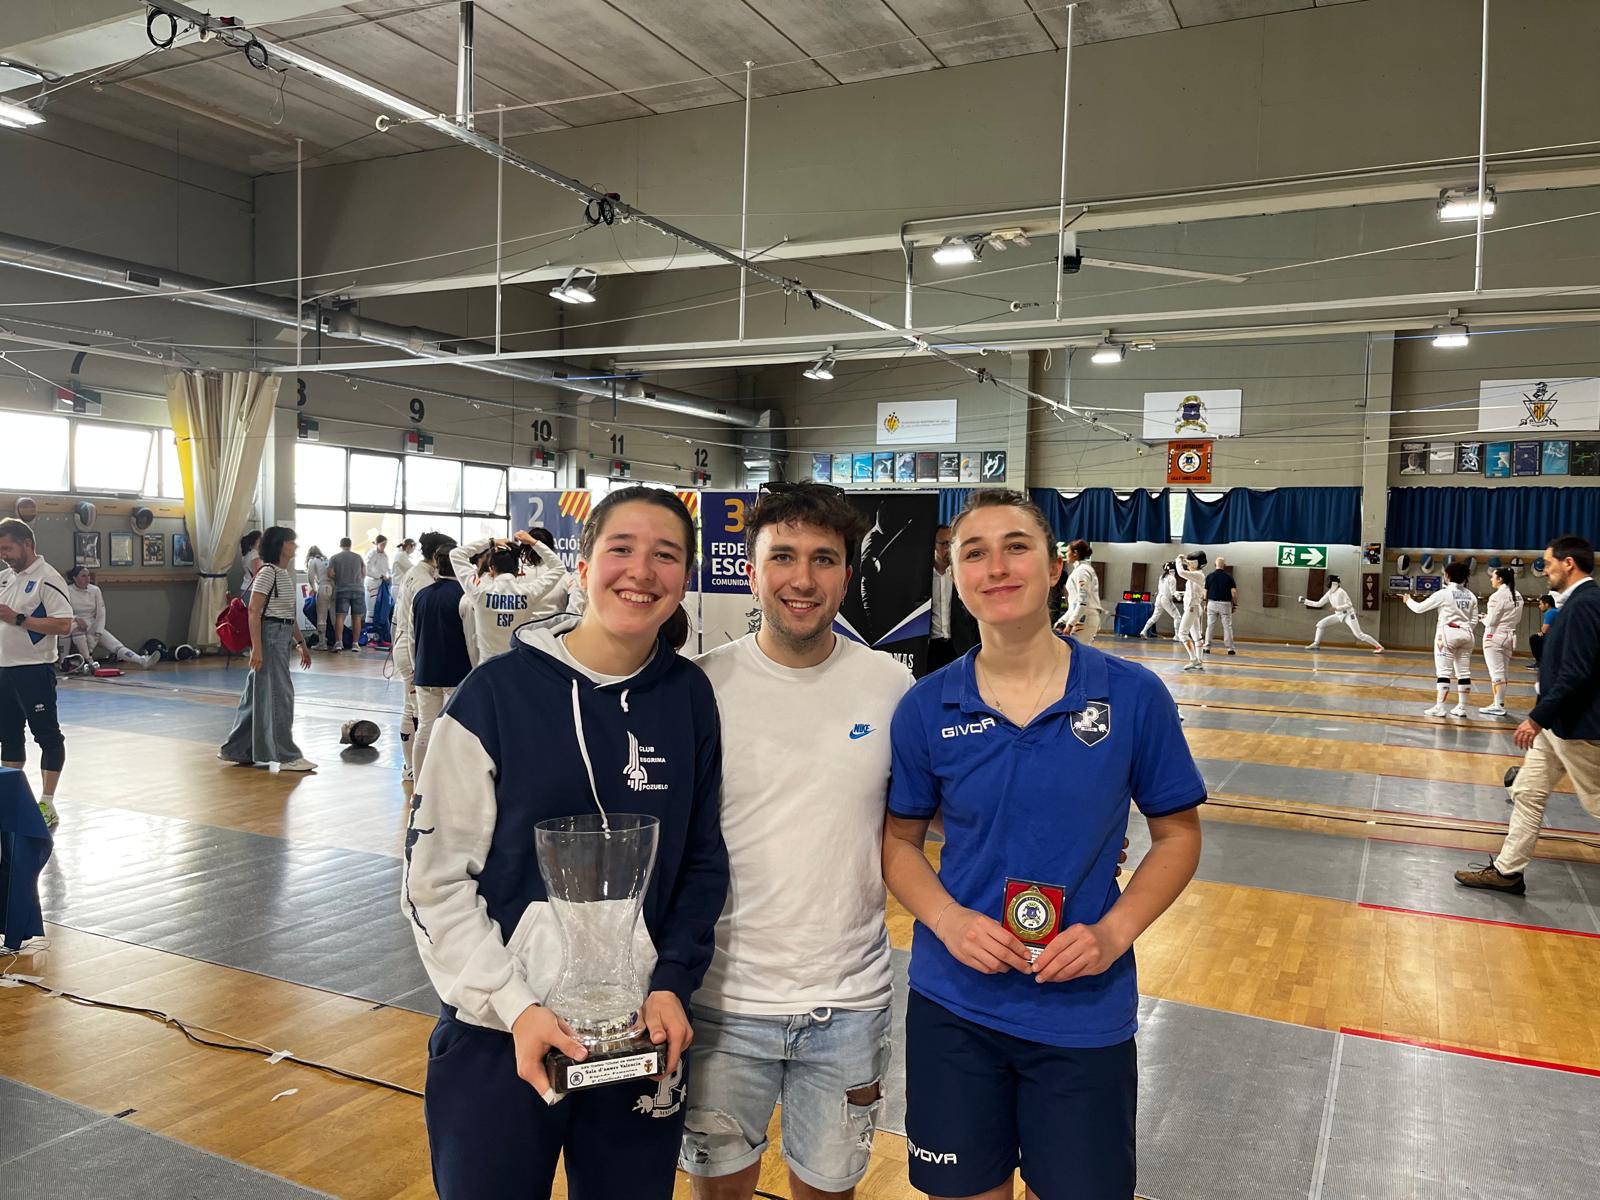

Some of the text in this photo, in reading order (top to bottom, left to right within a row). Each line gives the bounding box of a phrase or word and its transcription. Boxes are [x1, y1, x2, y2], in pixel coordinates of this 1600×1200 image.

[68, 341, 91, 374] 7
[409, 398, 425, 423] 9
[531, 420, 552, 442] 10
[610, 434, 624, 455] 11
[694, 448, 708, 467] 12
[528, 497, 545, 528] 2
[724, 498, 745, 532] 3
[711, 542, 748, 556] FEDE
[485, 593, 528, 610] TORRES
[1456, 600, 1470, 609] VEN
[497, 613, 514, 627] ESP
[853, 723, 870, 734] NIKE
